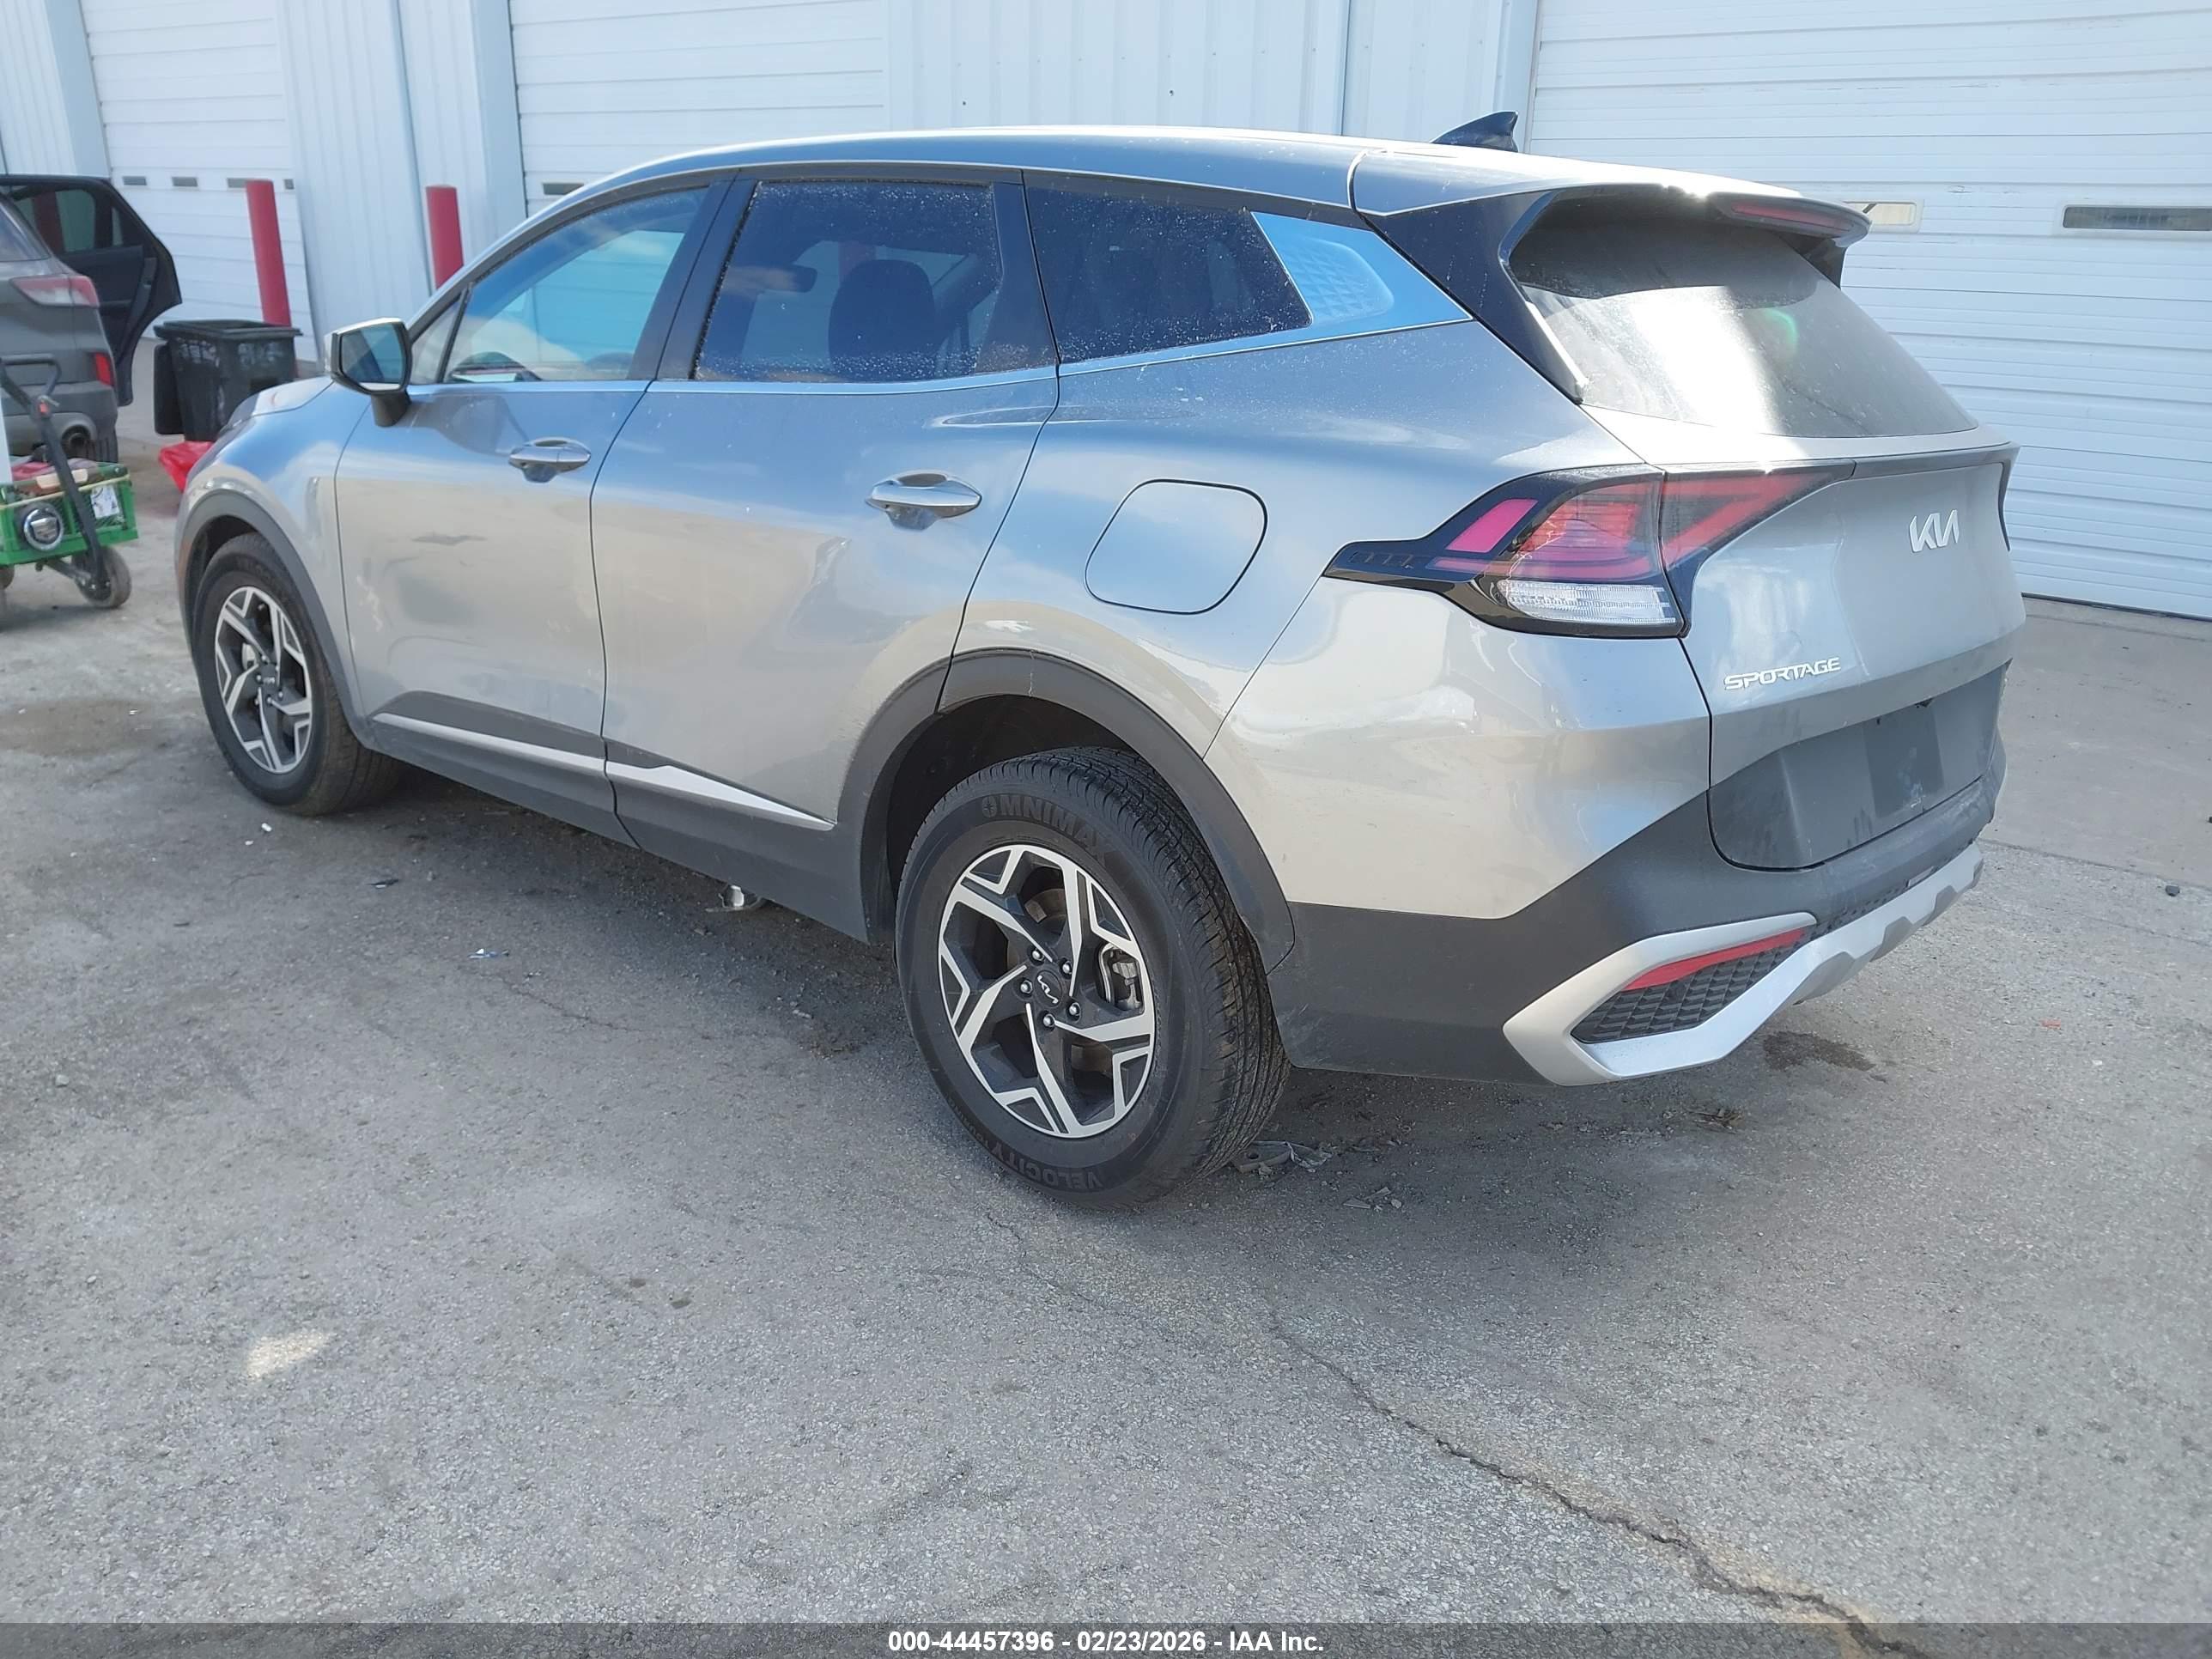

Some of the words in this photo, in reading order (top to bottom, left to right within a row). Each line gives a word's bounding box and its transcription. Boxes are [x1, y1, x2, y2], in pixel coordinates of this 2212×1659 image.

[1909, 508, 1960, 553] KIA
[1724, 657, 1842, 690] SPORTAGE
[981, 793, 1115, 867] OMNIMAX
[990, 1141, 1104, 1189] VELOCITY
